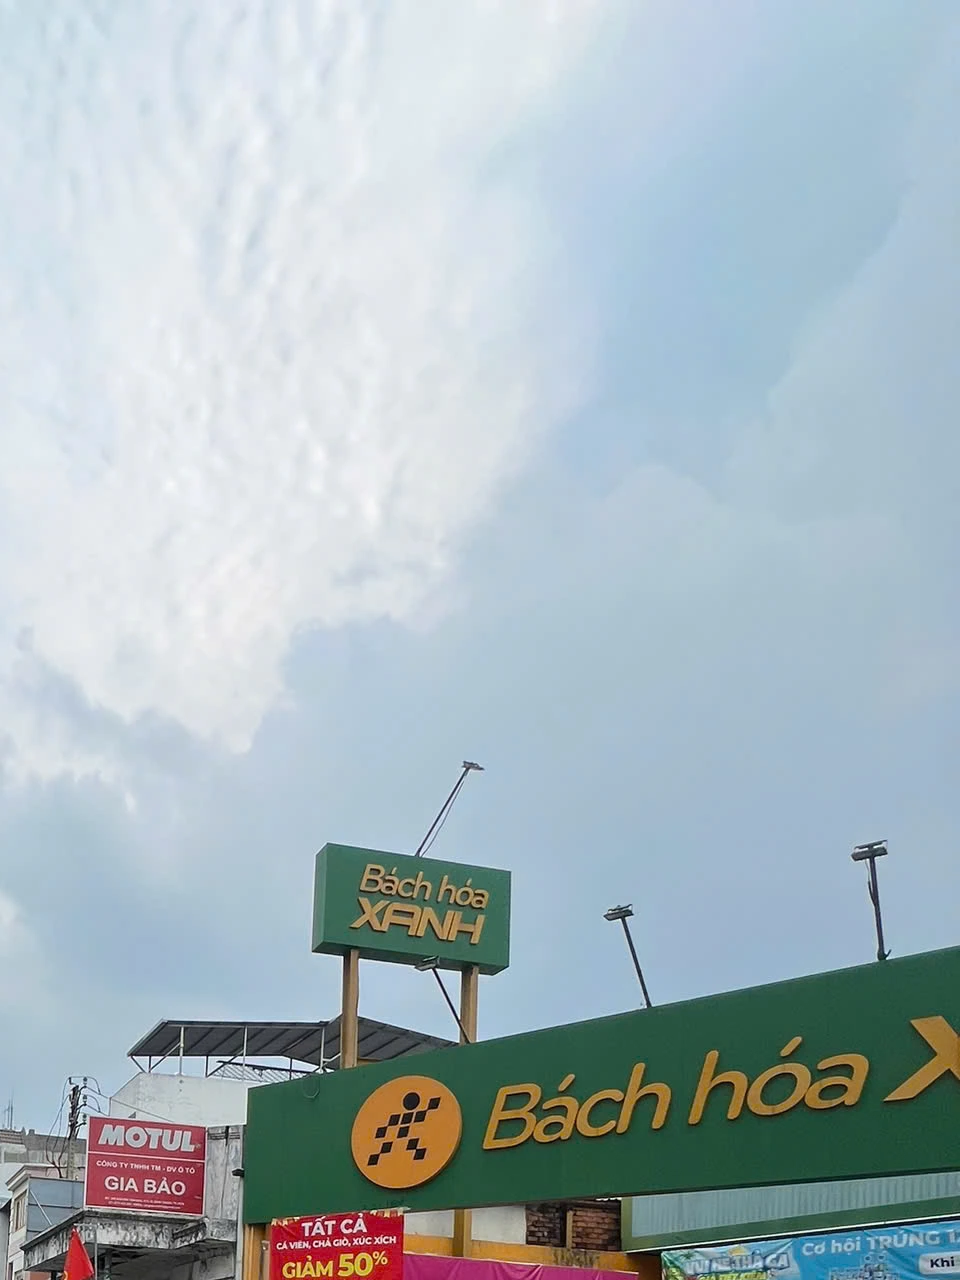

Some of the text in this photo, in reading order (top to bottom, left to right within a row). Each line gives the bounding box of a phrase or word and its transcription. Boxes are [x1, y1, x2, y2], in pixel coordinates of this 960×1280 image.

[359, 863, 489, 909] Bách hóa
[349, 897, 486, 945] XANH
[482, 1062, 671, 1150] Bách
[688, 1036, 870, 1126] hóa
[98, 1123, 195, 1152] MOTUL
[96, 1160, 117, 1168] CÔNG
[104, 1176, 186, 1195] GIA BẢO
[301, 1213, 367, 1237] TẤT CẢ
[276, 1242, 288, 1250] CÁ
[313, 1237, 332, 1248] CHẢ
[333, 1236, 351, 1247] GIÒ,
[352, 1235, 373, 1246] XÚC
[374, 1235, 396, 1244] XÍCH
[802, 1240, 826, 1256] Cơ
[831, 1236, 861, 1255] hội
[866, 1227, 940, 1250] TRÚNG
[282, 1251, 388, 1278] GIẢM 50%
[930, 1256, 955, 1268] Khi
